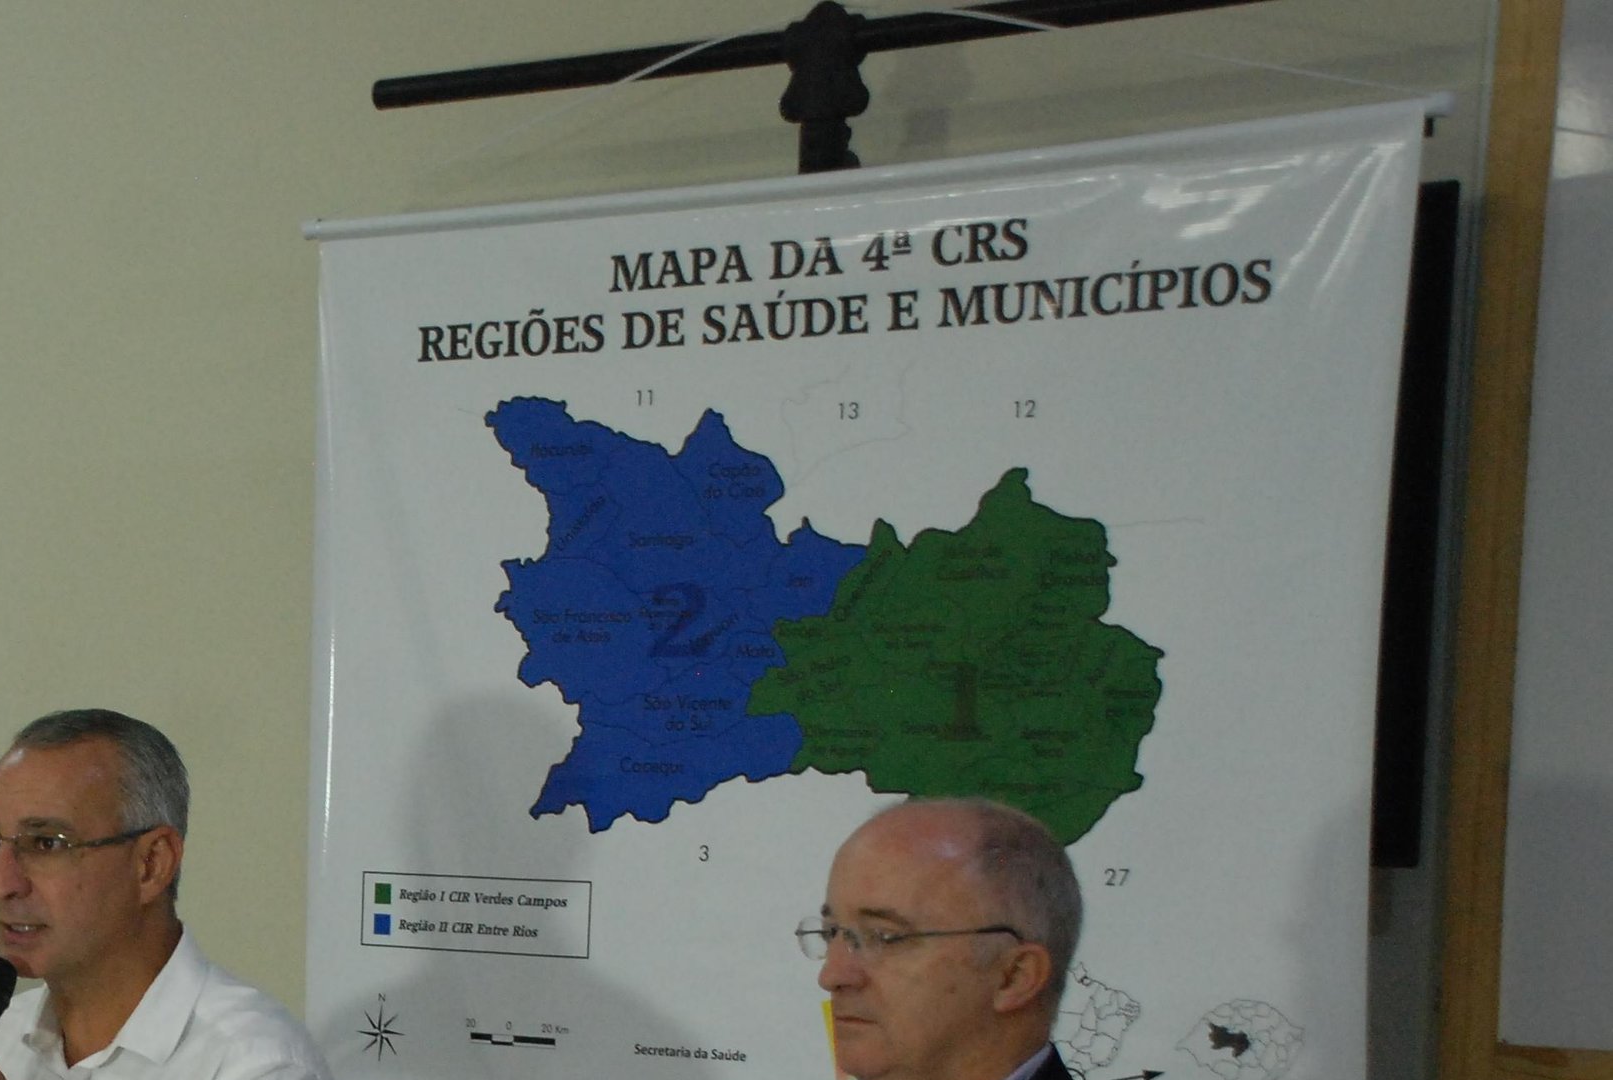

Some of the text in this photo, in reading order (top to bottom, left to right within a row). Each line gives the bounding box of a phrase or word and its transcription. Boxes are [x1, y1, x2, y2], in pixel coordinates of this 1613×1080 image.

[610, 247, 751, 293] MAPA
[772, 237, 843, 279] DA
[931, 218, 1030, 268] CRS
[418, 258, 1273, 362] REGIÕES DE SAÚDE E MUNICÍPIOS
[636, 389, 654, 408] 11
[837, 402, 860, 421] 13
[1013, 400, 1037, 420] 12
[629, 533, 695, 550] Santiago
[648, 582, 706, 658] 2
[698, 844, 710, 862] 3
[1104, 868, 1131, 887] 27
[399, 888, 437, 903] Região
[449, 890, 471, 904] CIR
[475, 891, 514, 907] Verdes
[517, 894, 568, 909] Campos
[399, 919, 436, 933] Região
[452, 921, 474, 935] CIR
[477, 924, 509, 936] Entre
[512, 925, 539, 939] Rios
[377, 993, 386, 1002] N
[634, 1043, 747, 1063] Secretaria da Saúde
